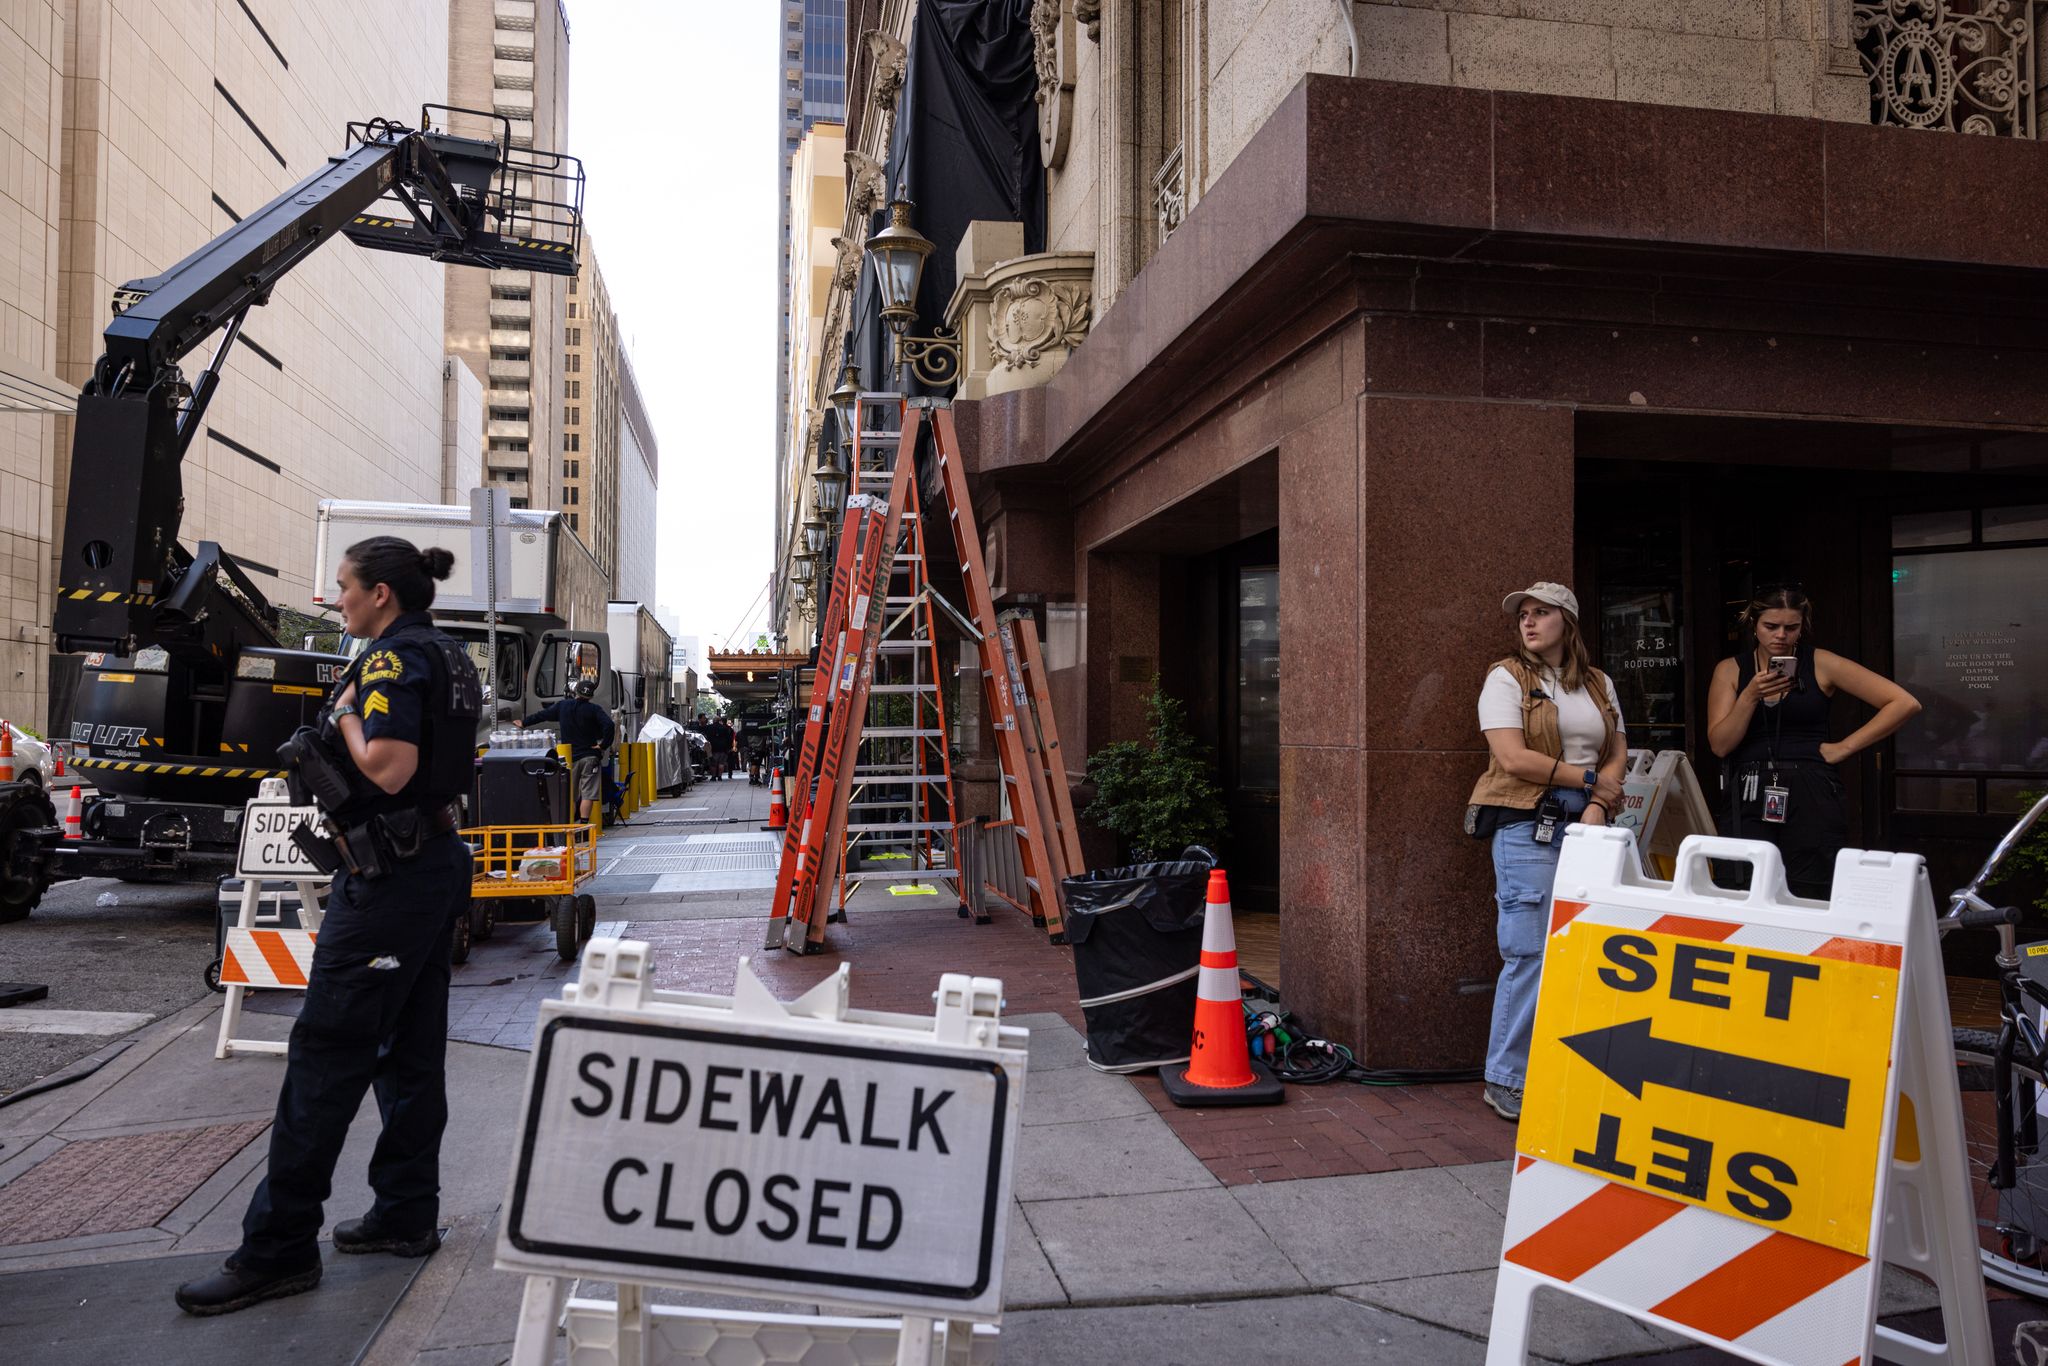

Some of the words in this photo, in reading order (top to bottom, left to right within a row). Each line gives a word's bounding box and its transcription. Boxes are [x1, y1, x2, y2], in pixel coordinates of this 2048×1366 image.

[868, 543, 895, 625] GRIPSTAR
[361, 669, 399, 686] DEPARTMENT
[1624, 659, 1655, 669] RODEO
[1659, 657, 1678, 667] BAR
[1969, 660, 1995, 668] ROOM
[1597, 933, 1821, 1021] SET
[570, 1052, 956, 1155] SIDEWALK
[602, 1157, 903, 1252] CLOSED
[1572, 1112, 1799, 1222] SET
